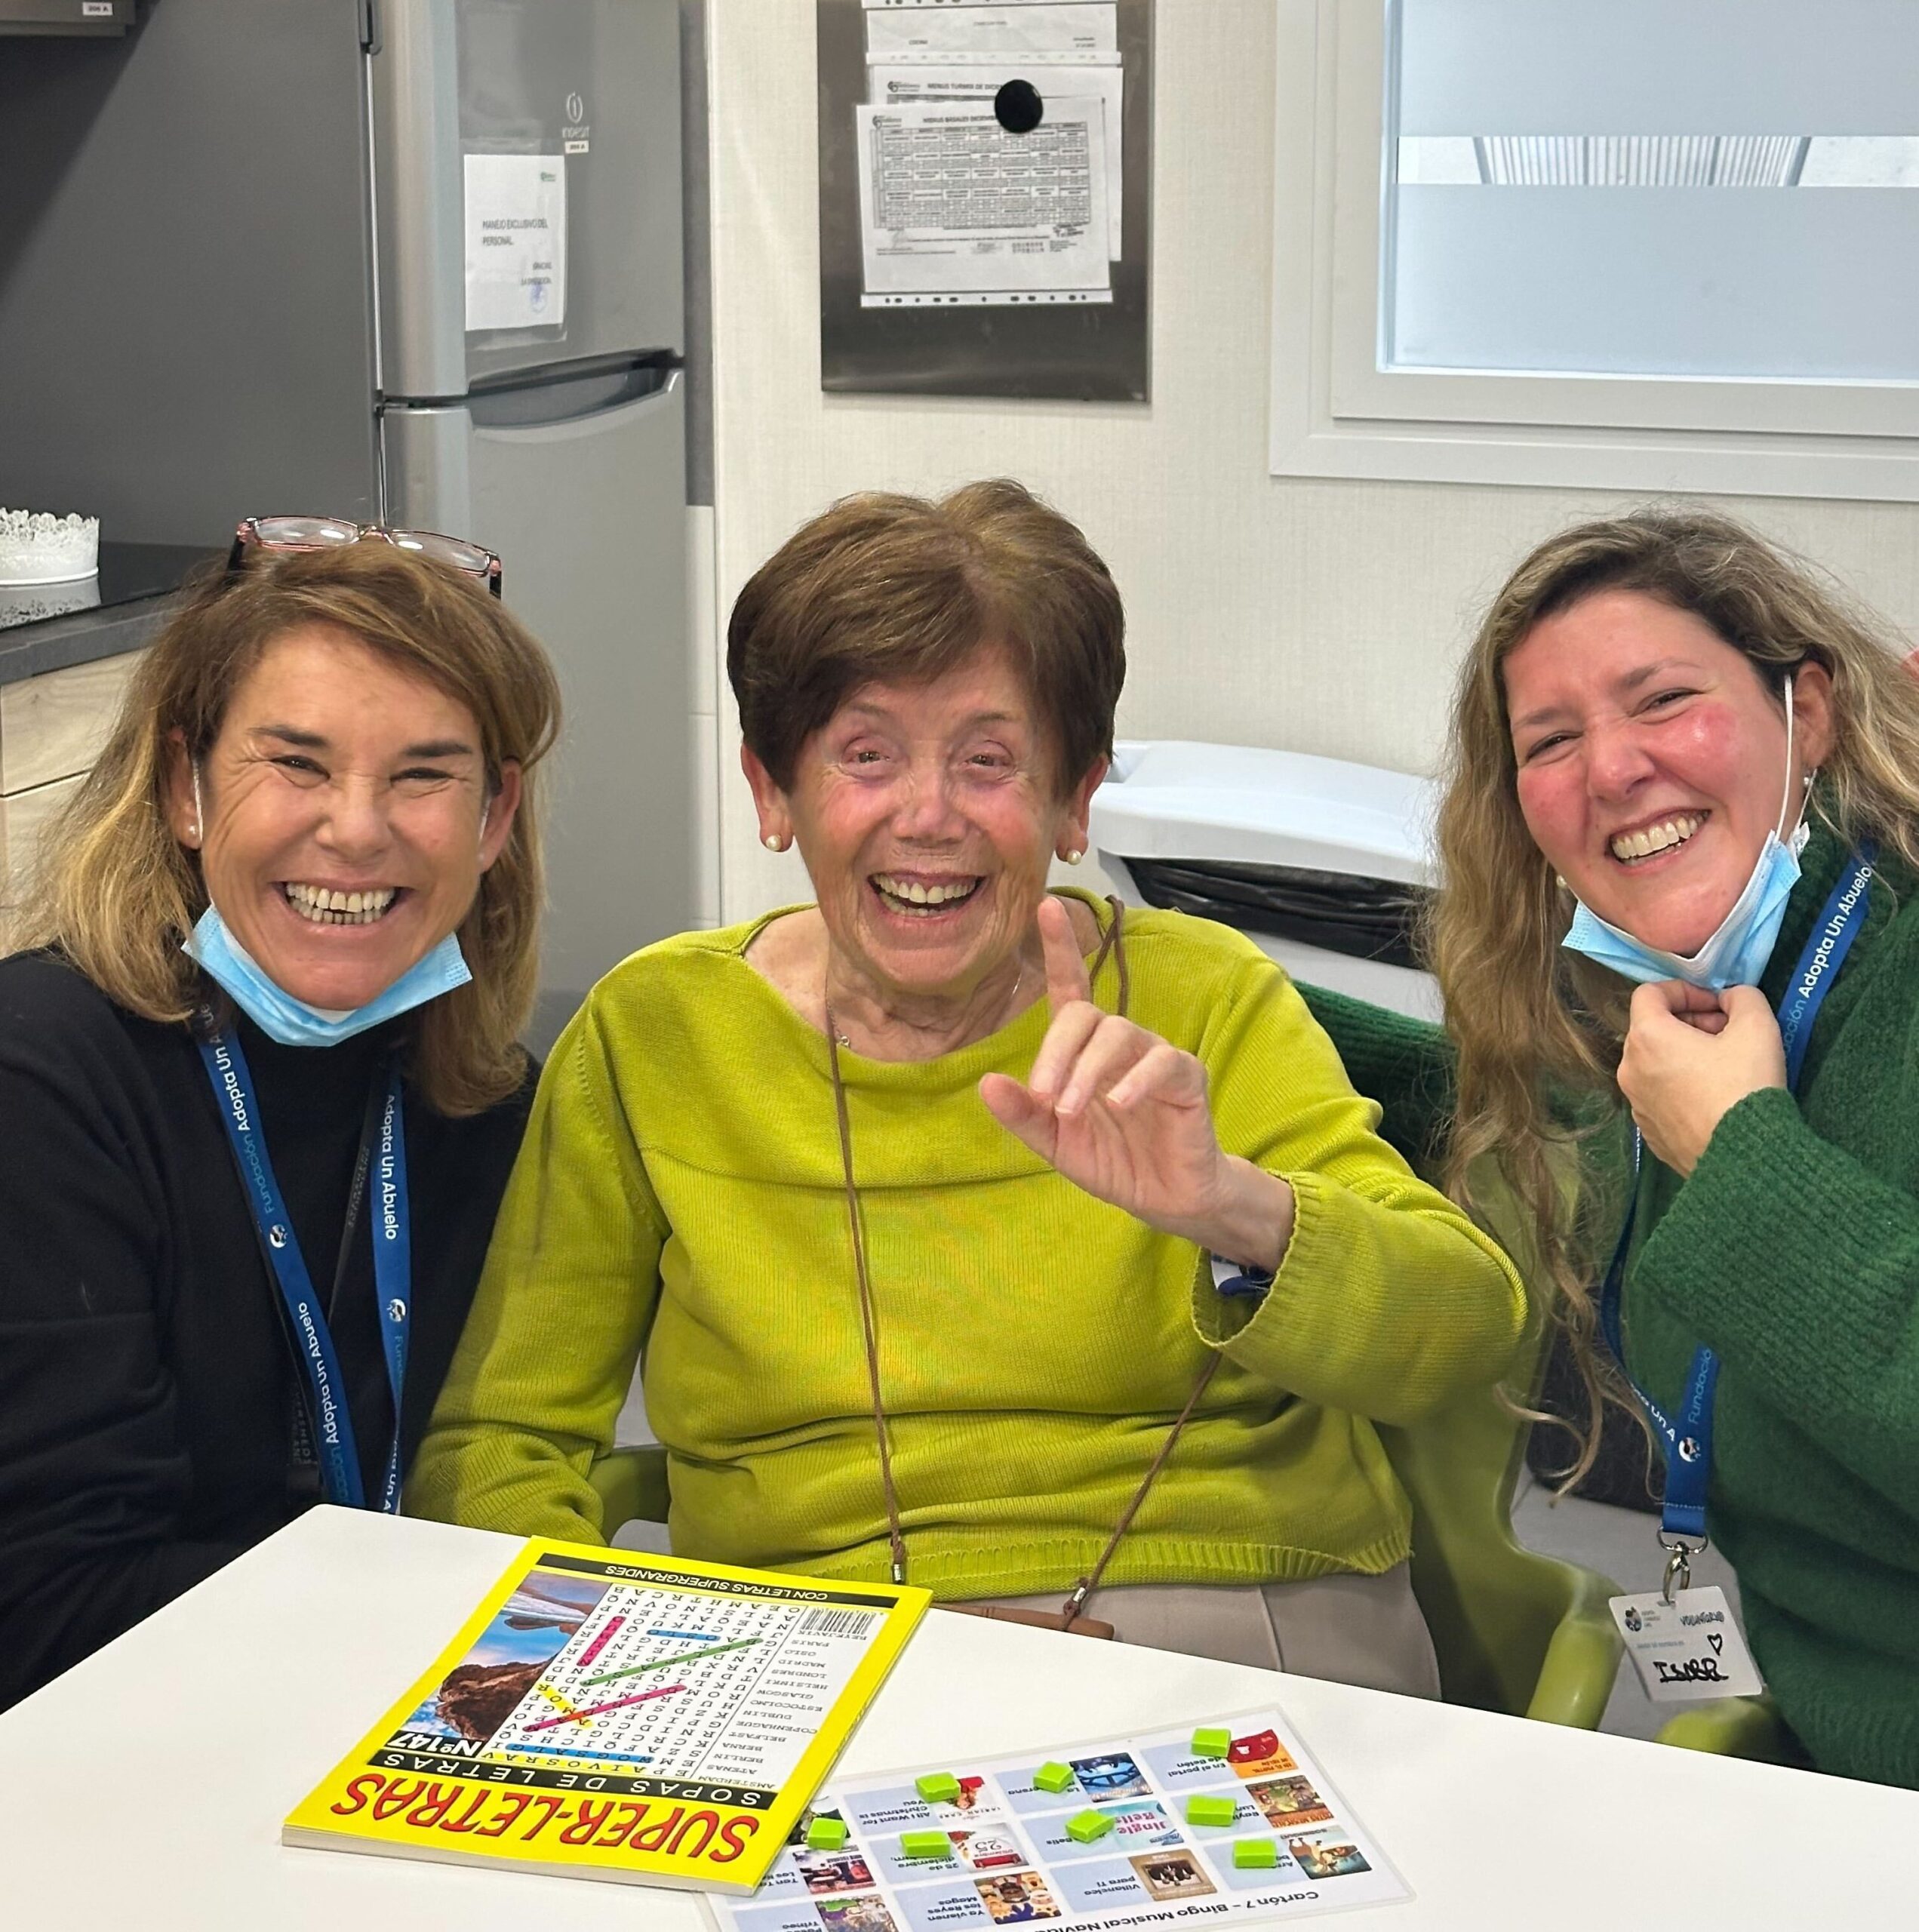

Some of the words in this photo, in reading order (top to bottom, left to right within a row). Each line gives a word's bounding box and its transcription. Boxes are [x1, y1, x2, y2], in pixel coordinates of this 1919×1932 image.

[482, 220, 506, 230] MANEJO
[507, 220, 537, 230] EXCLUSIVO
[537, 219, 548, 229] DEL
[1798, 937, 1835, 999] Adopta
[1824, 914, 1848, 937] Un
[1838, 866, 1872, 916] Abuelo
[215, 1046, 232, 1072] Un
[223, 1071, 251, 1131] Adopta
[381, 1096, 395, 1153] Adopta
[381, 1155, 394, 1179] Un
[381, 1181, 399, 1241] Abuelo
[298, 1302, 322, 1358] Abuelo
[316, 1359, 328, 1383] Un
[321, 1383, 340, 1444] Adopta
[604, 1565, 730, 1590] SUPERGRANDES
[731, 1583, 792, 1598] LETRAS
[792, 1590, 829, 1601] CON
[791, 1639, 830, 1647] PARIS
[783, 1649, 817, 1657] OSLO
[778, 1659, 826, 1669] MADRID
[770, 1669, 827, 1679] LONDRES
[764, 1678, 829, 1690] HELSINKI
[749, 1700, 823, 1712] ESTOCOLMO
[742, 1709, 792, 1721] DUBLIN
[736, 1720, 818, 1735] COPENHAGUE
[727, 1731, 787, 1743] BELFAST
[721, 1742, 763, 1752] BERNA
[713, 1753, 764, 1764] BERLIN
[1176, 1758, 1207, 1768] Belén
[383, 1753, 536, 1783] LETRAS
[706, 1764, 758, 1775] ATENAS
[1167, 1765, 1201, 1777] portal
[555, 1774, 607, 1790] DE
[697, 1775, 776, 1789] AMSTERDAM
[629, 1780, 761, 1806] SOPAS
[329, 1773, 761, 1863] SUPER-LETRAS
[869, 1805, 928, 1817] Christmas
[878, 1814, 910, 1823] Want
[1116, 1821, 1167, 1835] Jingle
[974, 1839, 1002, 1854] 25
[1108, 1875, 1136, 1885] para
[938, 1896, 978, 1906] Magos
[1246, 1900, 1256, 1909] 7
[1256, 1891, 1320, 1906] Cartón
[927, 1905, 963, 1915] Reyes
[1176, 1903, 1229, 1917] Bingo
[1103, 1911, 1175, 1930] Musical
